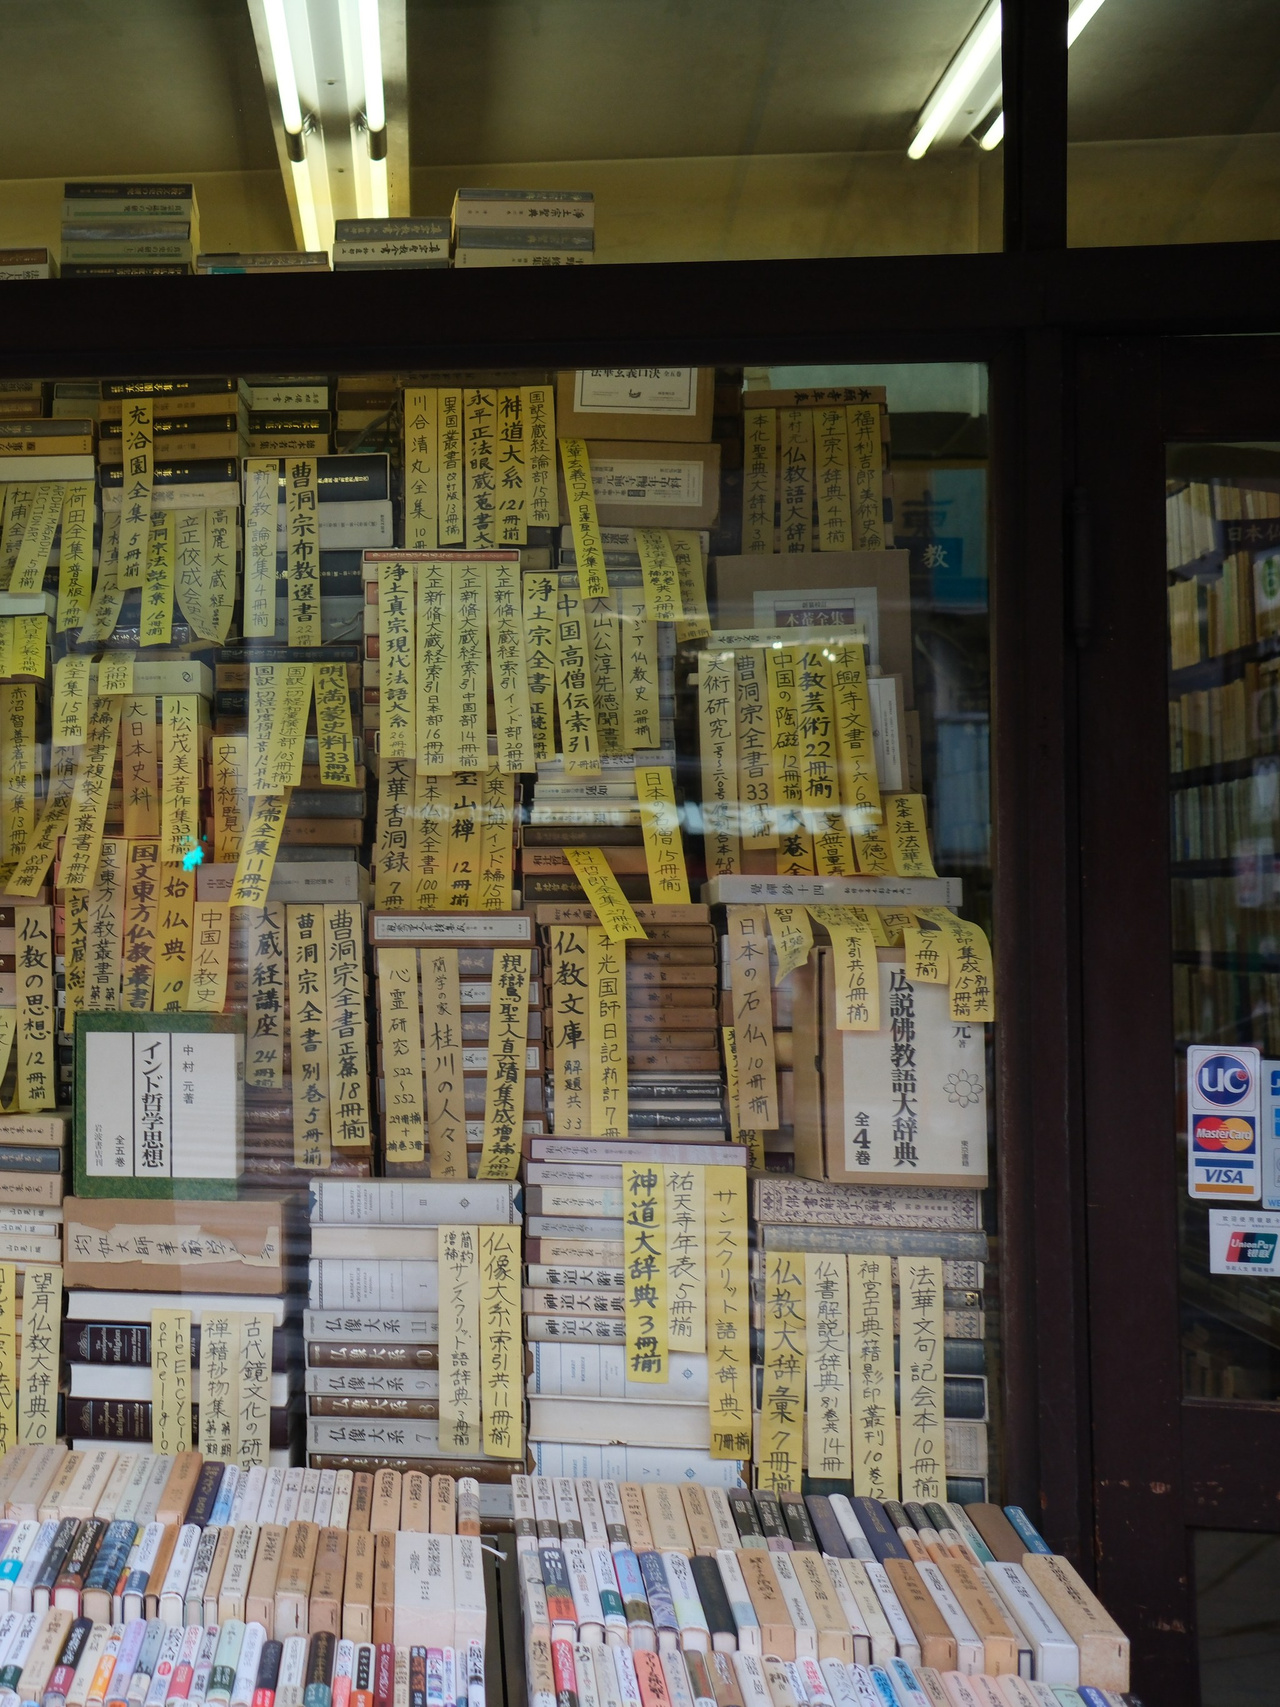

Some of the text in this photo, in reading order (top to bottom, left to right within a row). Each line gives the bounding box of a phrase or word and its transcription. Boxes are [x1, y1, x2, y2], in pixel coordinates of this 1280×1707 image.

[25, 486, 51, 543] DICTIONARY
[124, 406, 153, 579] 充洽園全集5冊揃
[467, 390, 495, 549] 永平正法眼蔵蒐書大
[499, 395, 525, 541] 神道大系121冊揃
[527, 391, 550, 522] 国訳大蔵経論部15冊揃
[821, 411, 847, 544] 浄土宗大辞典4冊揃
[629, 604, 654, 744] アジア仏教史20冊揃
[737, 655, 771, 839] 曹洞宗全書33冊揃
[773, 652, 801, 800] 中国の陶磁12冊揃
[795, 652, 833, 798] 仏教芸術22冊揃
[128, 701, 152, 812] 大日本史料
[125, 843, 159, 1009] 国文東方仏教叢書
[17, 918, 51, 1100] 仏教の思想12冊揃
[295, 912, 327, 1166] 曹洞宗全書別巻5冊揃
[388, 968, 411, 1057] 心霊研究
[738, 918, 770, 1123] 日本の石仏10冊揃
[890, 968, 919, 1168] 広説佛教語大辞典
[1201, 1067, 1248, 1094] UC
[141, 1040, 165, 1168] インド哲学思想
[853, 1111, 872, 1166] 全4巻
[1196, 1128, 1252, 1141] MasterCard
[1204, 1168, 1245, 1184] VISA
[626, 1168, 663, 1373] 神道大辞典3冊揃
[666, 1170, 701, 1338] 祐天寺年表5冊揃
[713, 1189, 744, 1421] サンスクリット語大辞典
[1231, 1239, 1275, 1252] UnionPay
[22, 1271, 56, 1448] 望月仏教大辞典10
[325, 1317, 401, 1334] 仏像大系
[329, 1377, 405, 1391] 仏像大系
[909, 1266, 940, 1499] 法華文句記会本10冊揃
[328, 1429, 405, 1443] 仏像大系
